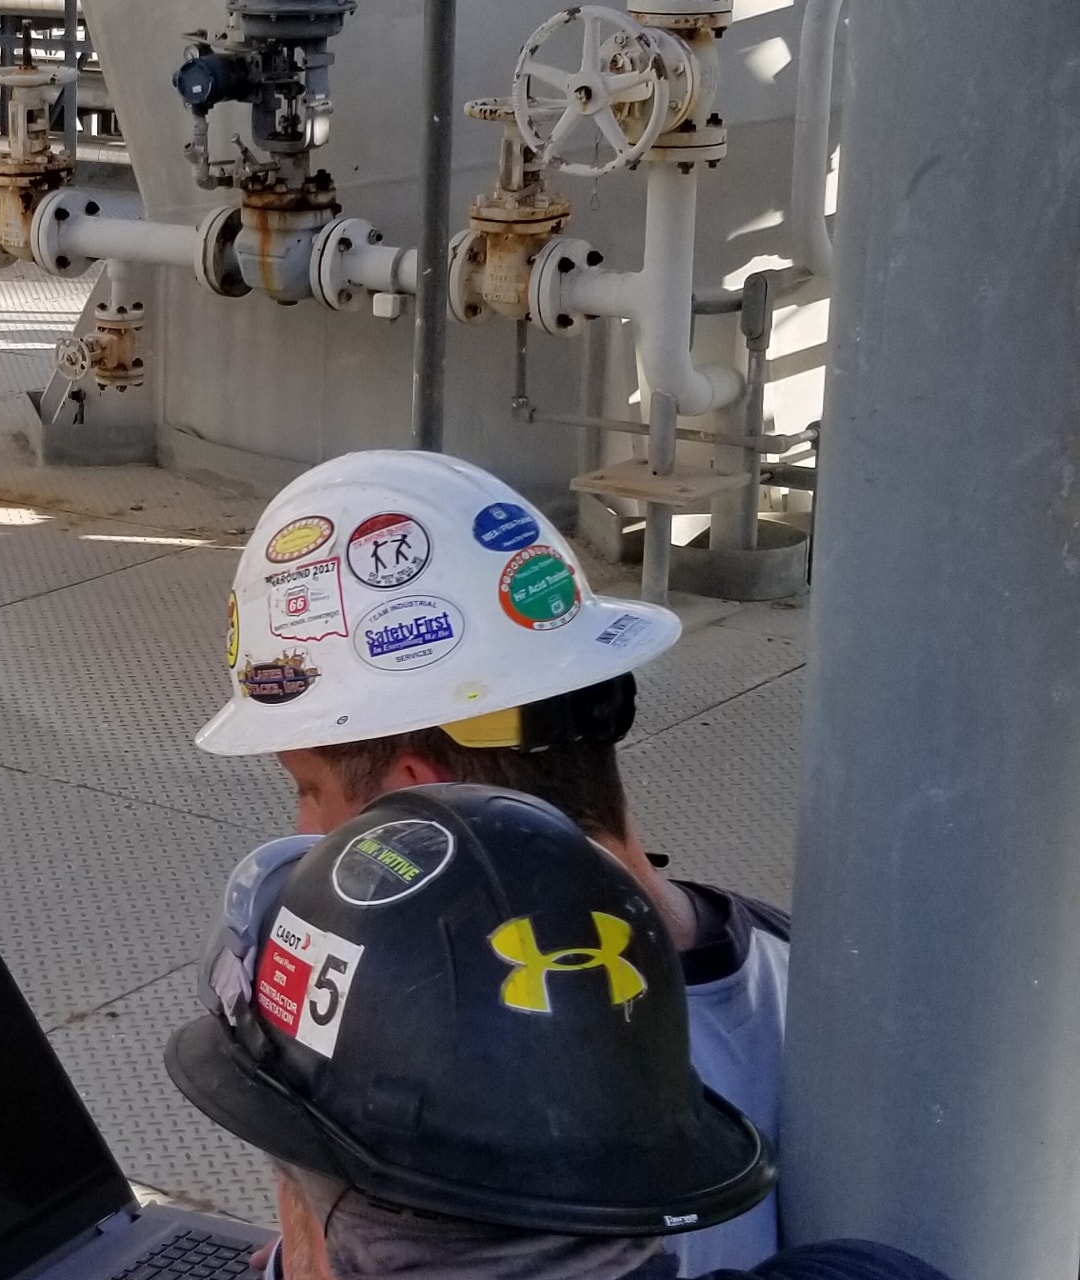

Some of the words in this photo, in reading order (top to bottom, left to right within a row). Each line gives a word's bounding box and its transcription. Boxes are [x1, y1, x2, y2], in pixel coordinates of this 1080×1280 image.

[312, 562, 336, 577] 2017
[288, 597, 306, 614] 66
[276, 925, 302, 951] CABOT
[259, 980, 298, 1015] CONTRACTOR
[309, 952, 350, 1027] 5
